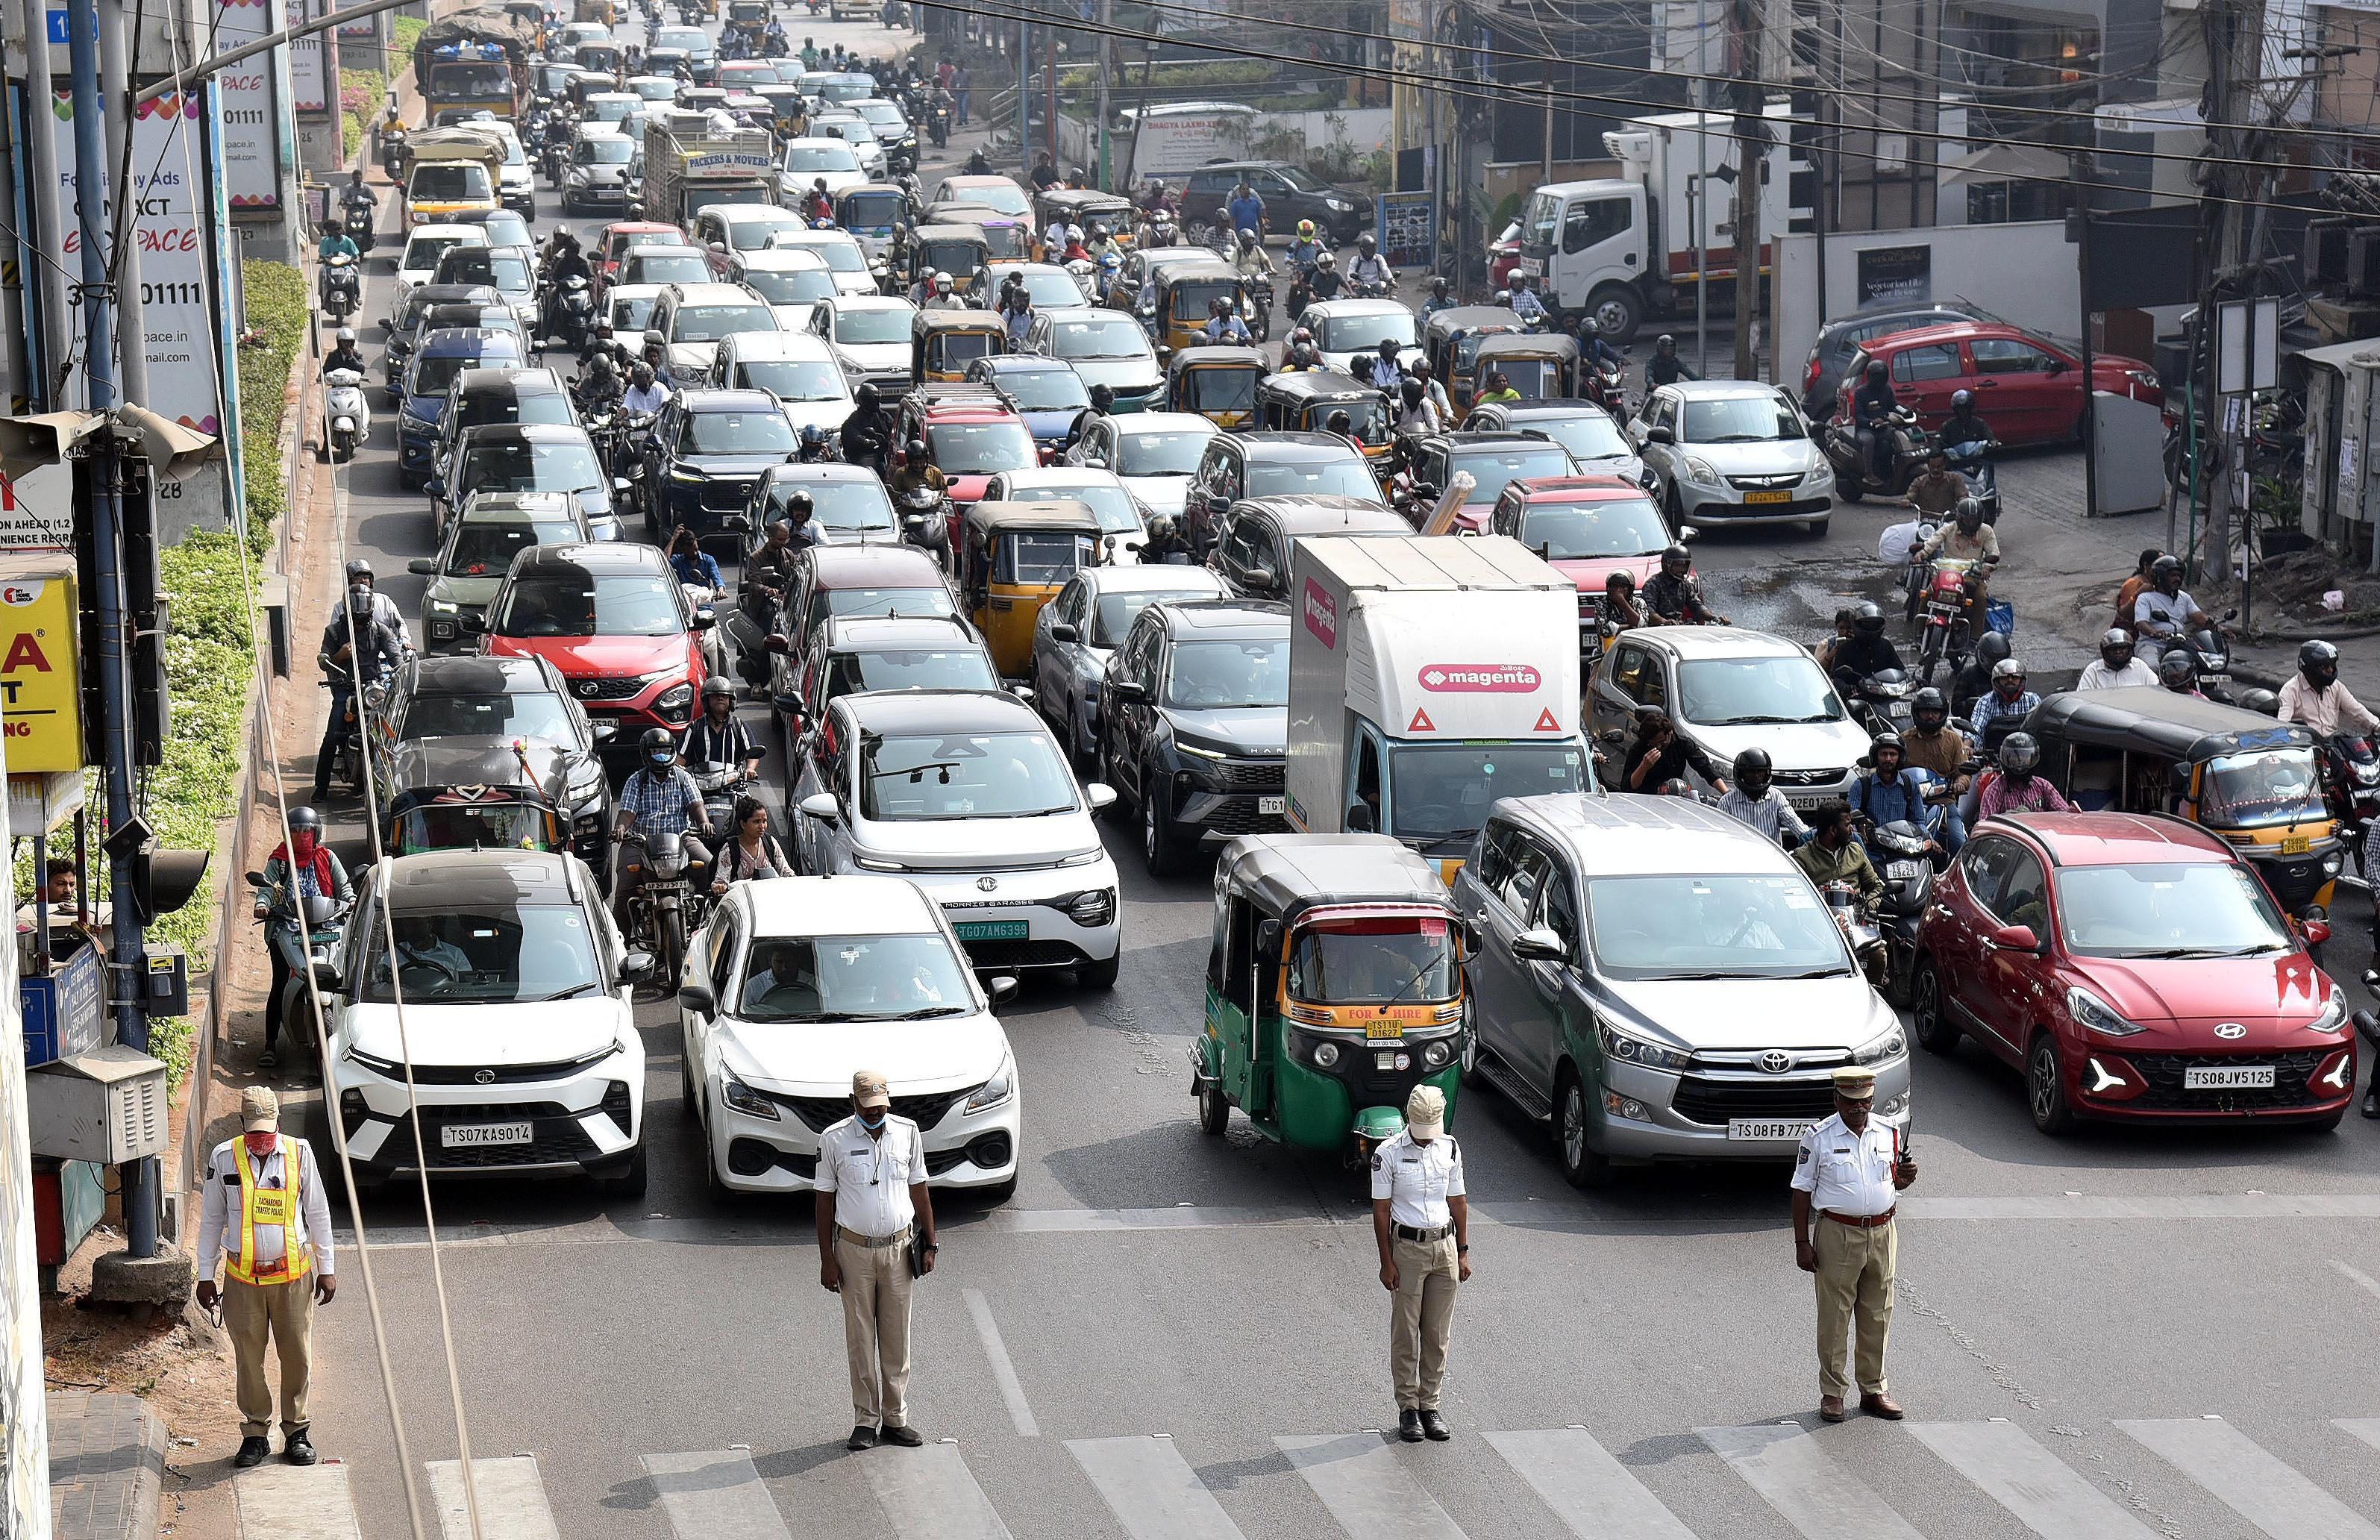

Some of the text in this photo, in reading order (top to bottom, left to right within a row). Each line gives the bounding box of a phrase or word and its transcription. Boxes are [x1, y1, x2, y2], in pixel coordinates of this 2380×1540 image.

[689, 154, 769, 168] PACKERS & MOVERS
[15, 519, 50, 529] AHEAD
[1449, 670, 1536, 686] magenta
[1349, 1010, 1421, 1018] FOR HIRE
[2194, 1071, 2273, 1084] TS08JV5125
[451, 1127, 529, 1142] TS07KA9014
[255, 1206, 284, 1216] TRAFFIC POLICE
